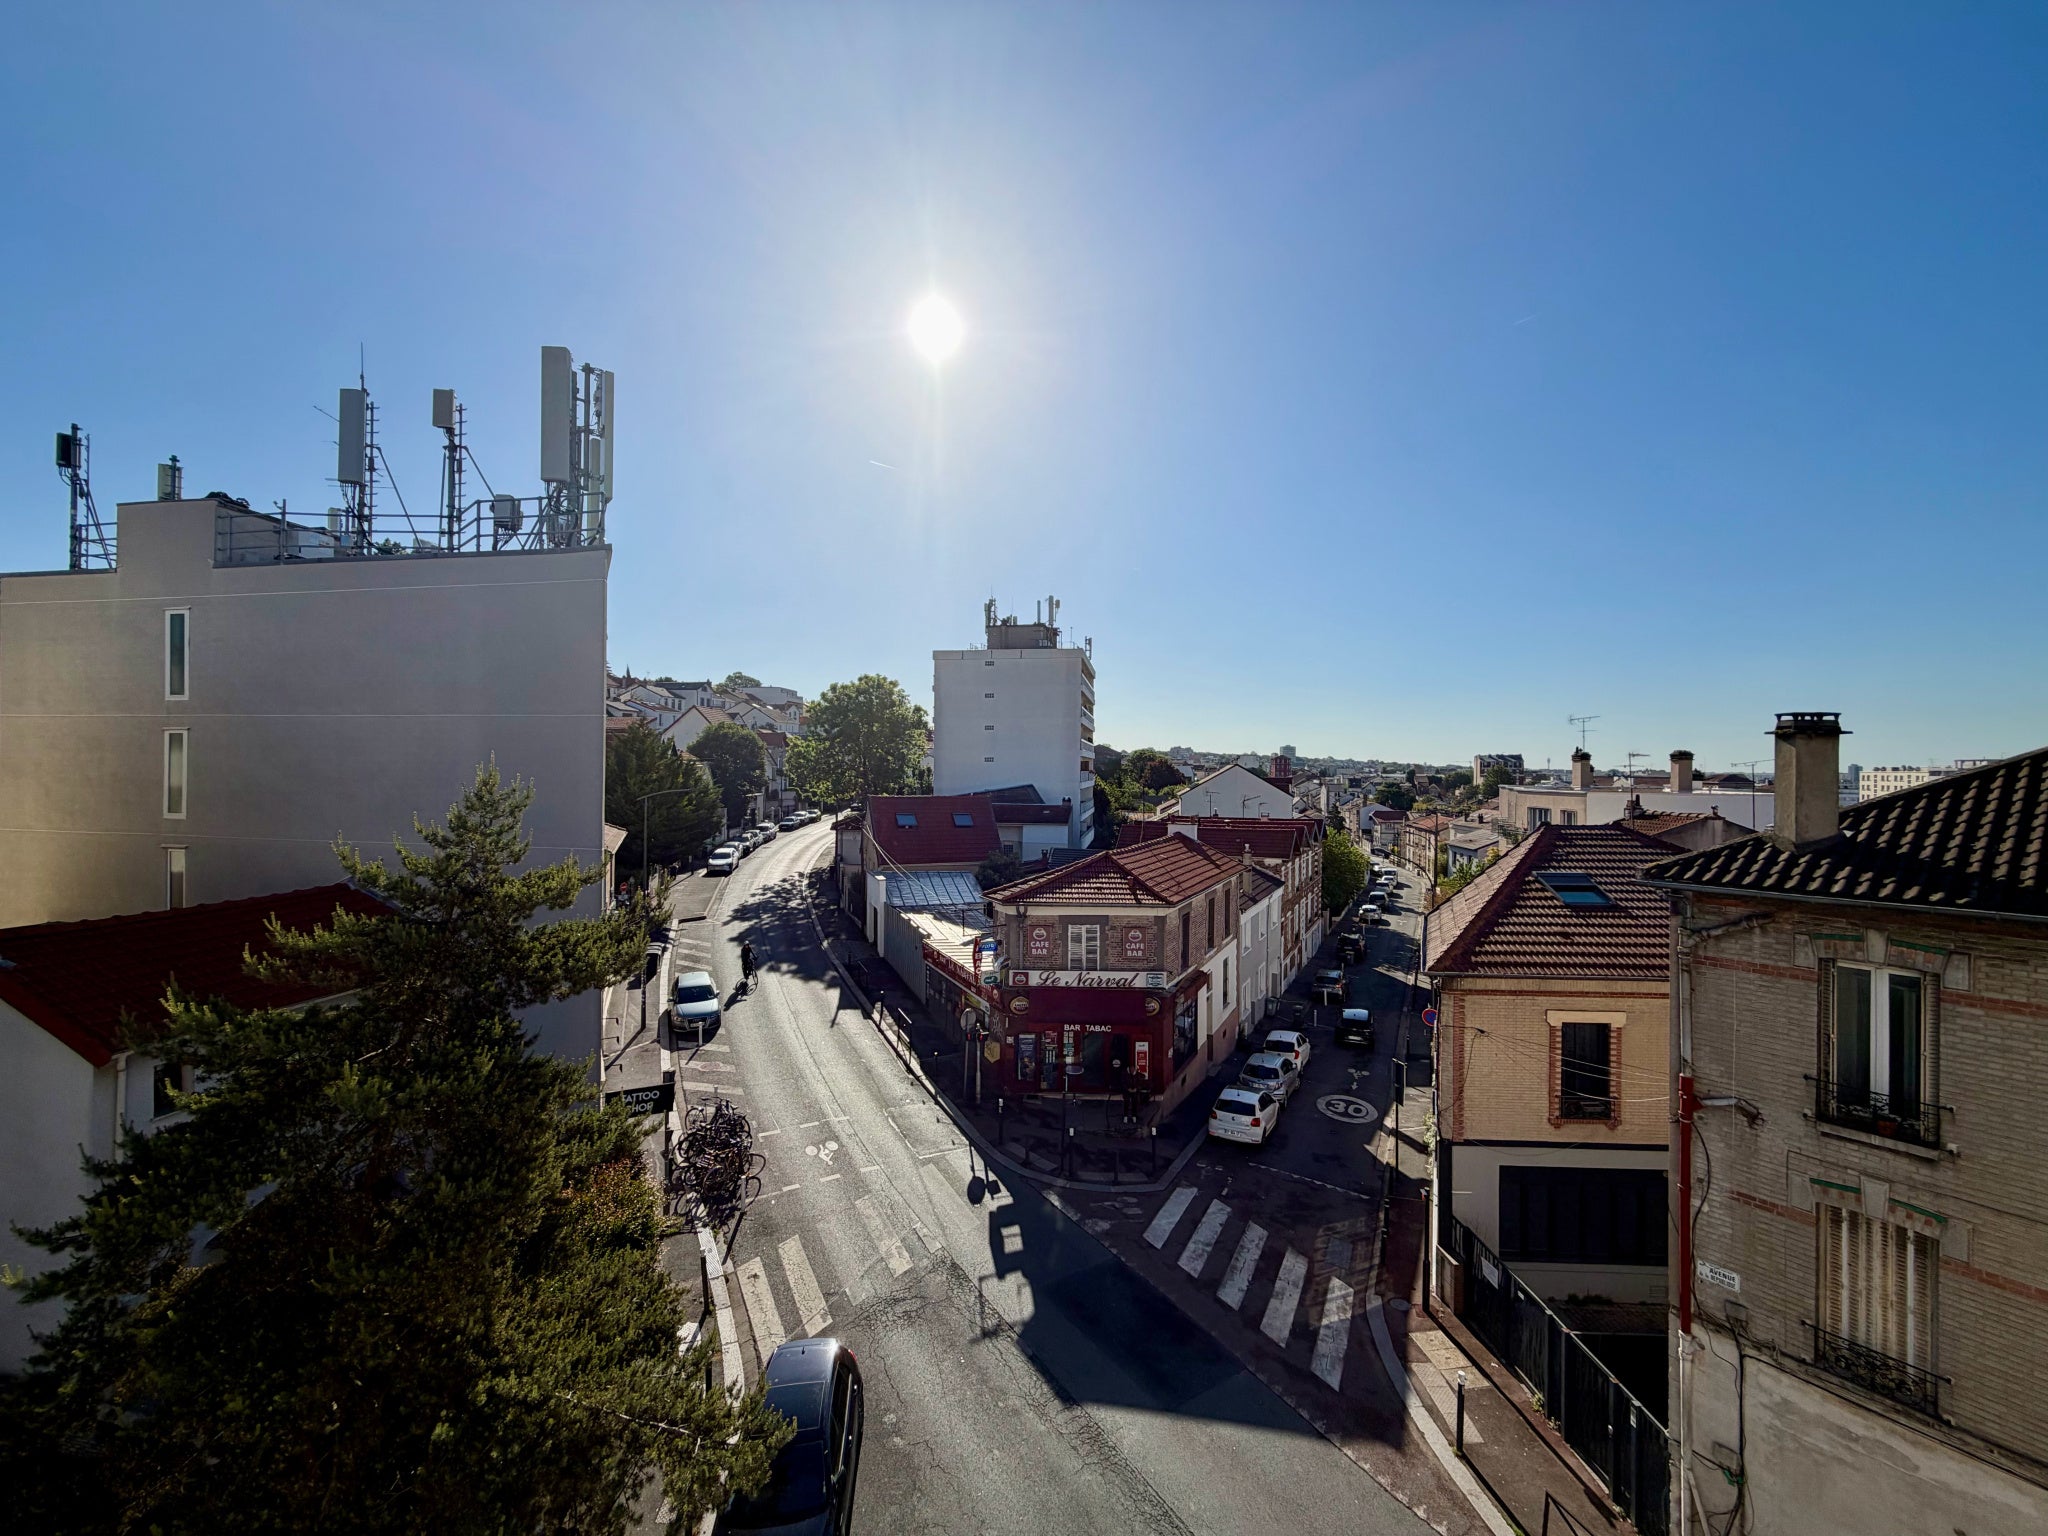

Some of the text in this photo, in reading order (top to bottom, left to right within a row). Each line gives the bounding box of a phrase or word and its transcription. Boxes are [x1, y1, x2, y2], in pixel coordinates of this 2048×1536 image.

[1036, 970, 1060, 986] Le
[1065, 971, 1139, 987] Narval
[1085, 1024, 1112, 1032] TABAC
[1327, 1100, 1368, 1117] 30
[1709, 1267, 1736, 1284] AVENUE
